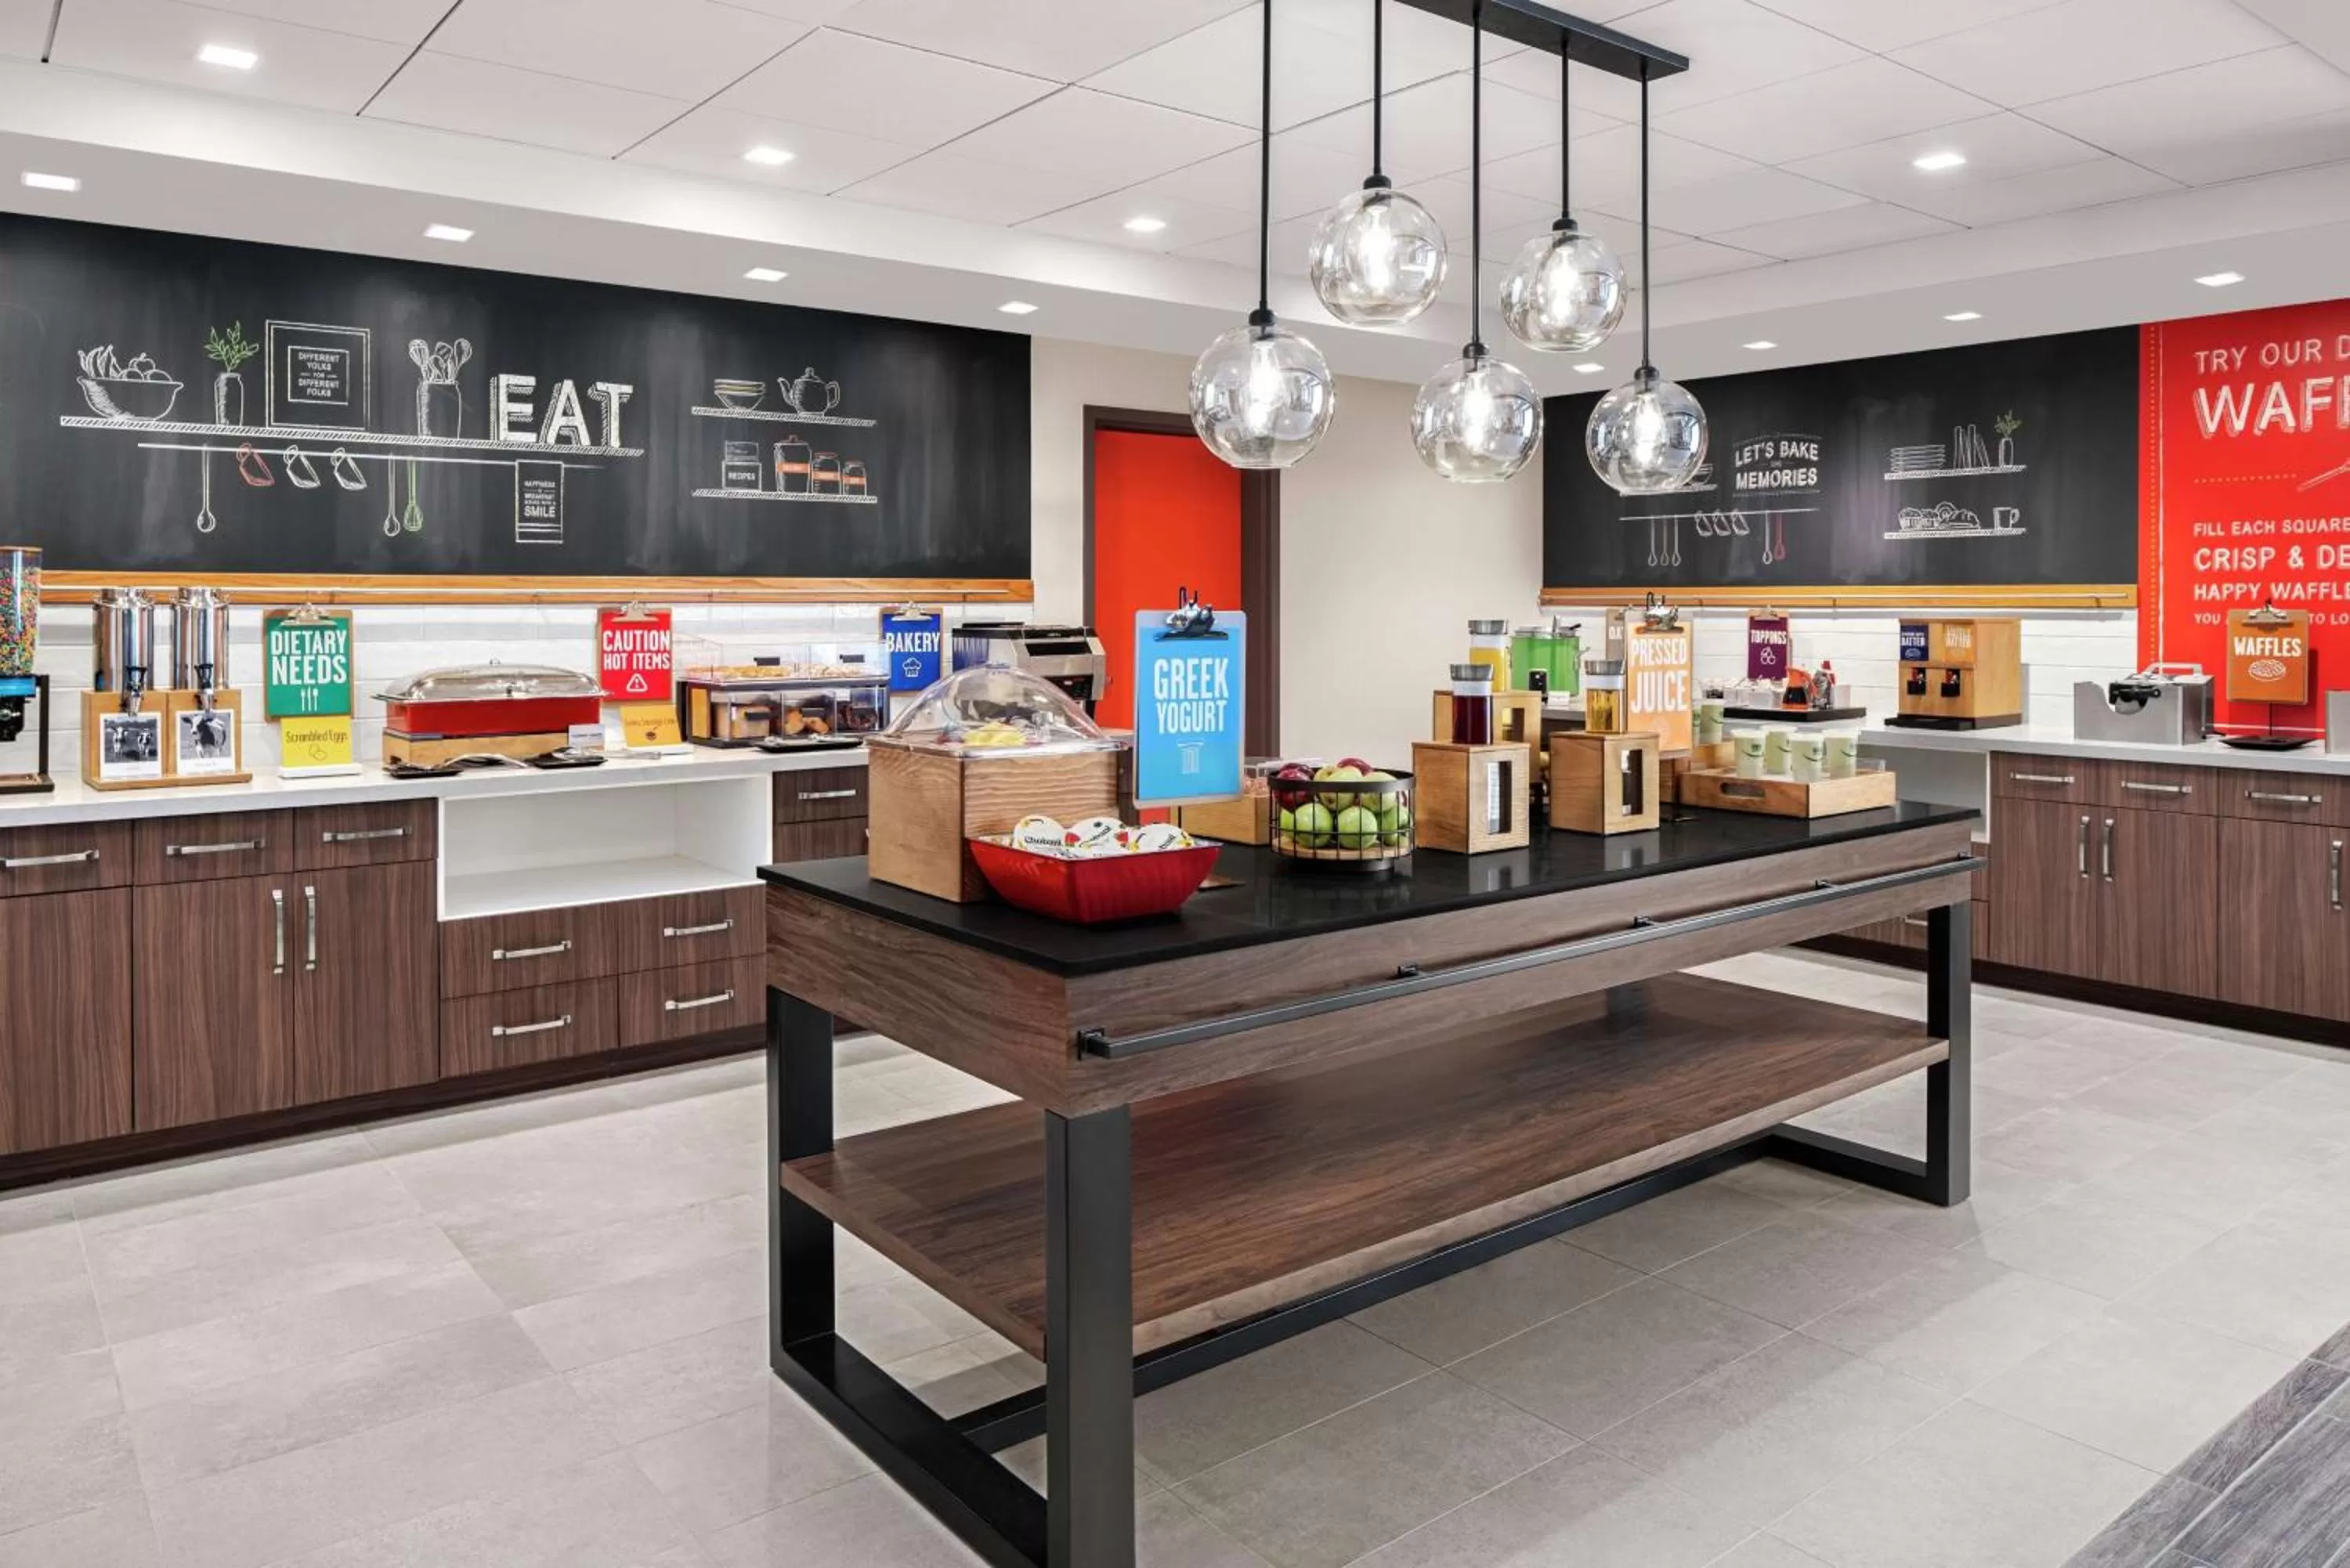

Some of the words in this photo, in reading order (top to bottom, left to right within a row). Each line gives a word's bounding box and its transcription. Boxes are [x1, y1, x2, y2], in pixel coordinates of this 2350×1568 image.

[298, 352, 339, 363] DIFFERENT
[306, 361, 331, 370] YOLKS
[2194, 346, 2247, 375] TRY
[2261, 338, 2323, 367] OUR
[298, 378, 339, 389] DIFFERENT
[306, 388, 331, 397] FOLKS
[490, 374, 634, 448] EAT
[1735, 441, 1774, 468] LET'S
[1779, 440, 1820, 461] BAKE
[1735, 468, 1818, 490] MEMORIES
[524, 505, 556, 518] SMILE
[2193, 522, 2225, 537] FILL
[2231, 520, 2276, 536] EACH
[2193, 546, 2276, 572] CRISP
[2288, 544, 2305, 570] &
[2194, 583, 2261, 601] HAPPY
[2194, 612, 2221, 626] YOU
[2308, 612, 2326, 625] TO
[269, 630, 347, 656] DIETARY
[602, 629, 671, 652] CAUTION
[885, 631, 940, 652] BAKERY
[1751, 629, 1787, 645] TOPPINGS
[2233, 636, 2302, 658] WAFFLES
[603, 652, 628, 670] HOT
[632, 652, 671, 670] ITEMS
[1630, 638, 1687, 668] PRESSED
[271, 654, 347, 685] NEEDS
[1153, 657, 1229, 700] GREEK
[1630, 669, 1689, 714] JUICE
[1155, 699, 1227, 735] YOGURT
